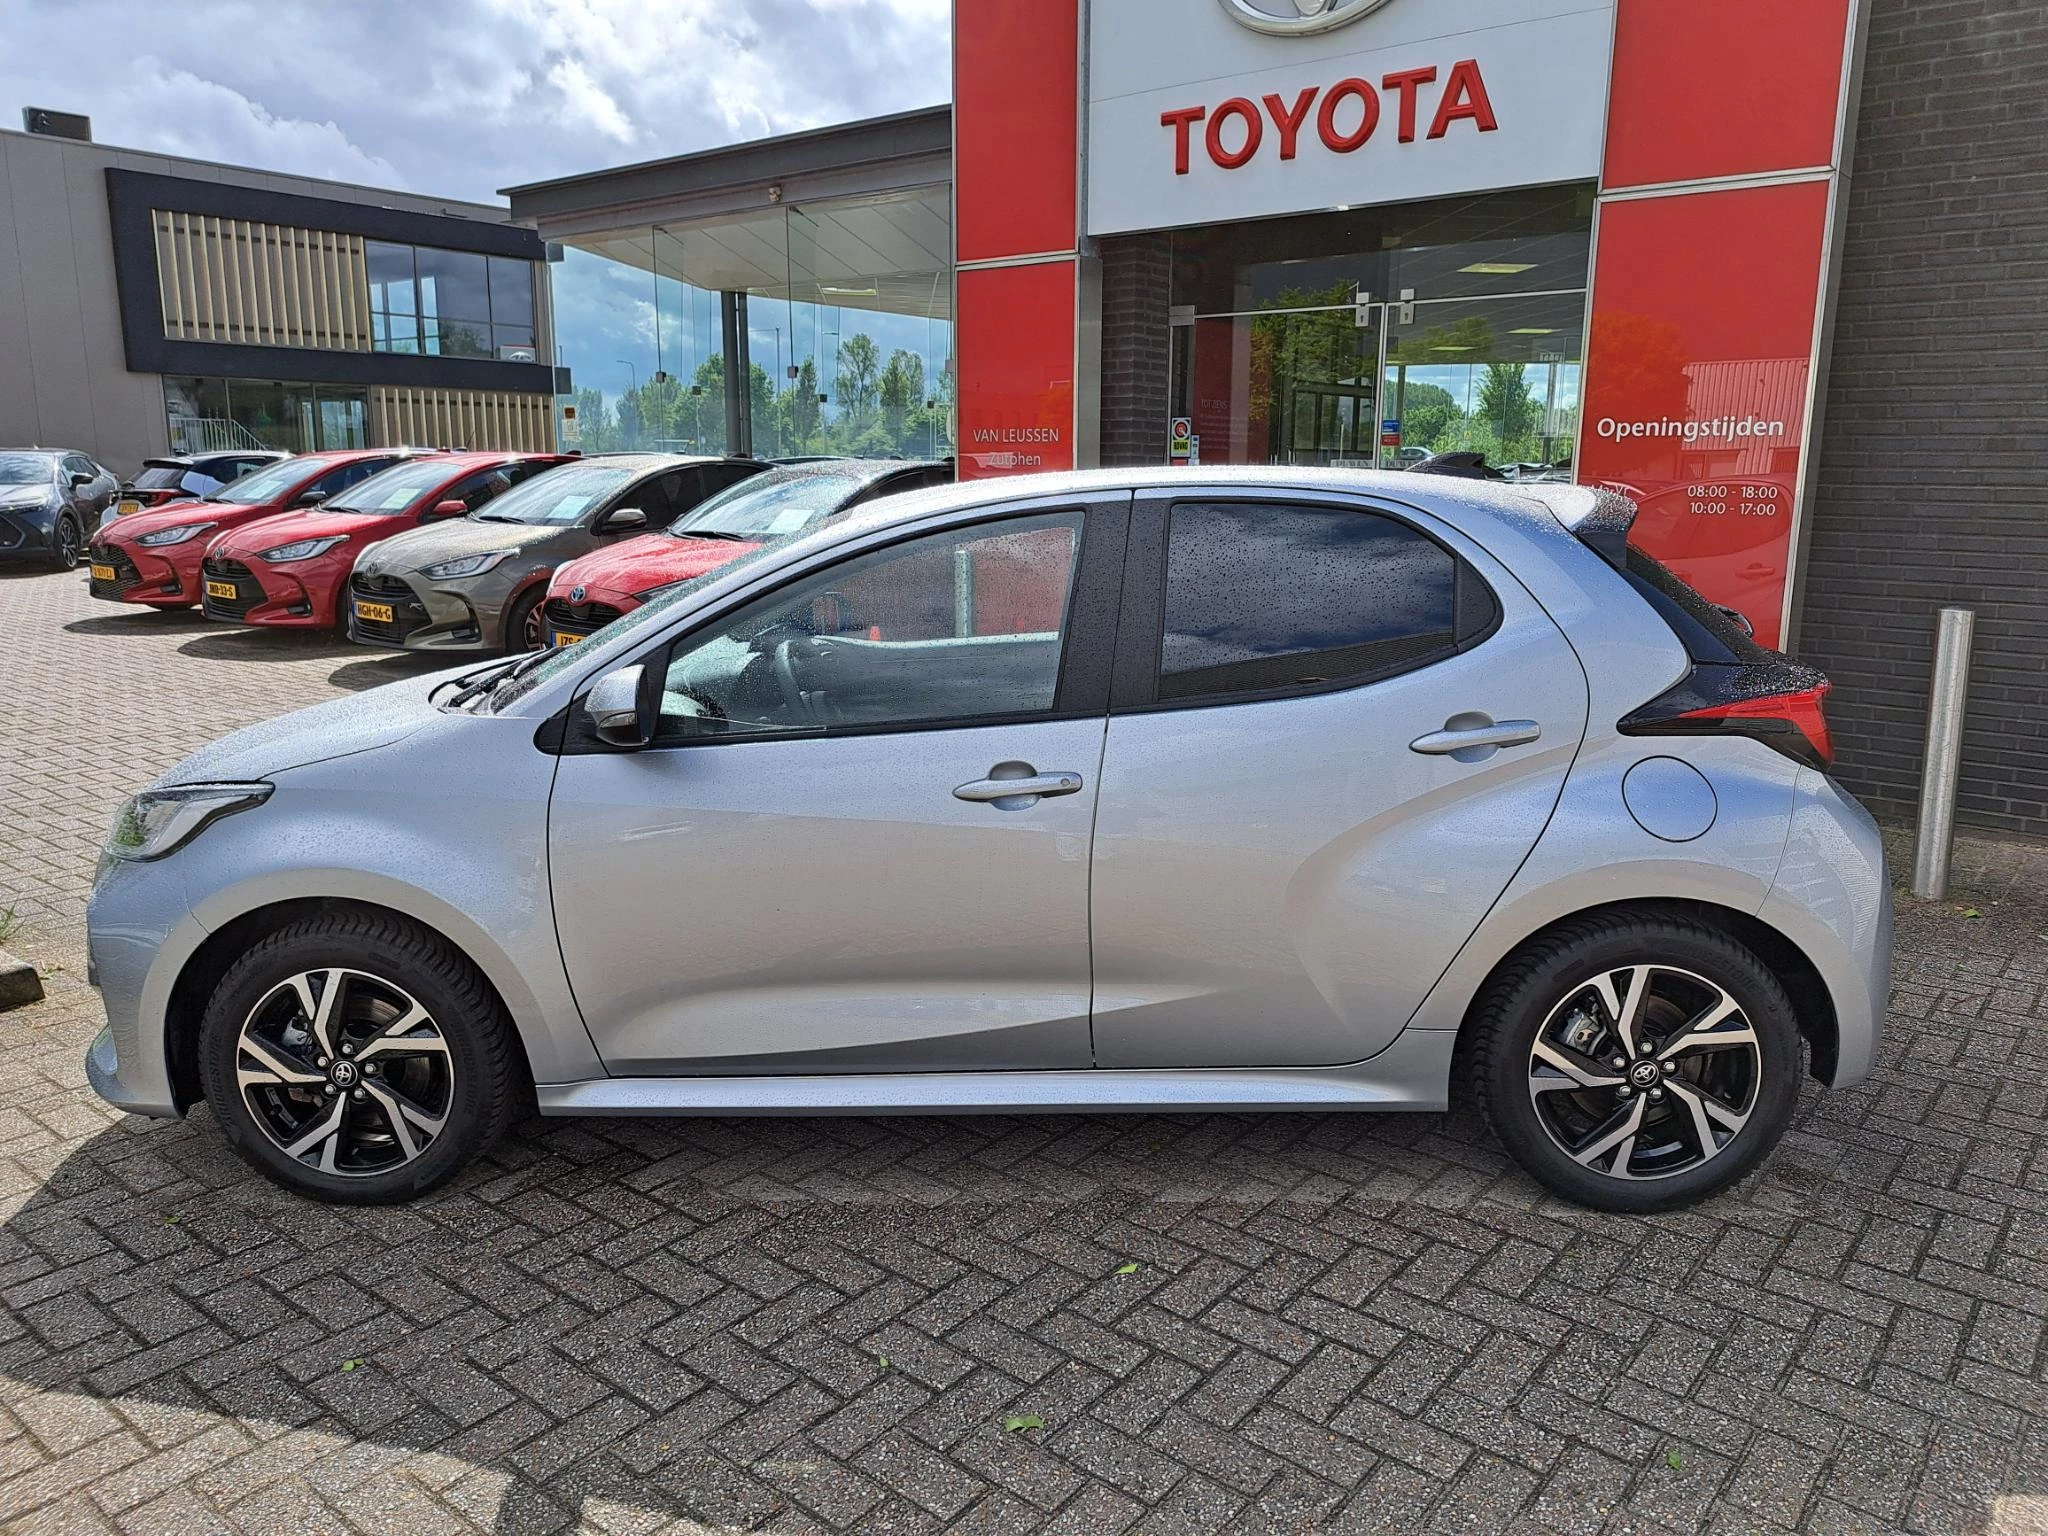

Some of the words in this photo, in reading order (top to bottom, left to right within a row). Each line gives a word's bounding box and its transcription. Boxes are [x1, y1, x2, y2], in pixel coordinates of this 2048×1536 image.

[1160, 58, 1499, 175] TOYOTA
[973, 428, 999, 442] VAN
[1002, 428, 1060, 442] LEUSSEN
[1597, 415, 1784, 442] Openingstijden
[990, 451, 1041, 470] Zutphen
[1687, 485, 1728, 498] 08:00
[1740, 486, 1778, 499] 18:00
[1689, 502, 1726, 514] 10:00
[1739, 503, 1776, 515] 17:00
[357, 604, 391, 620] HGH-06-G
